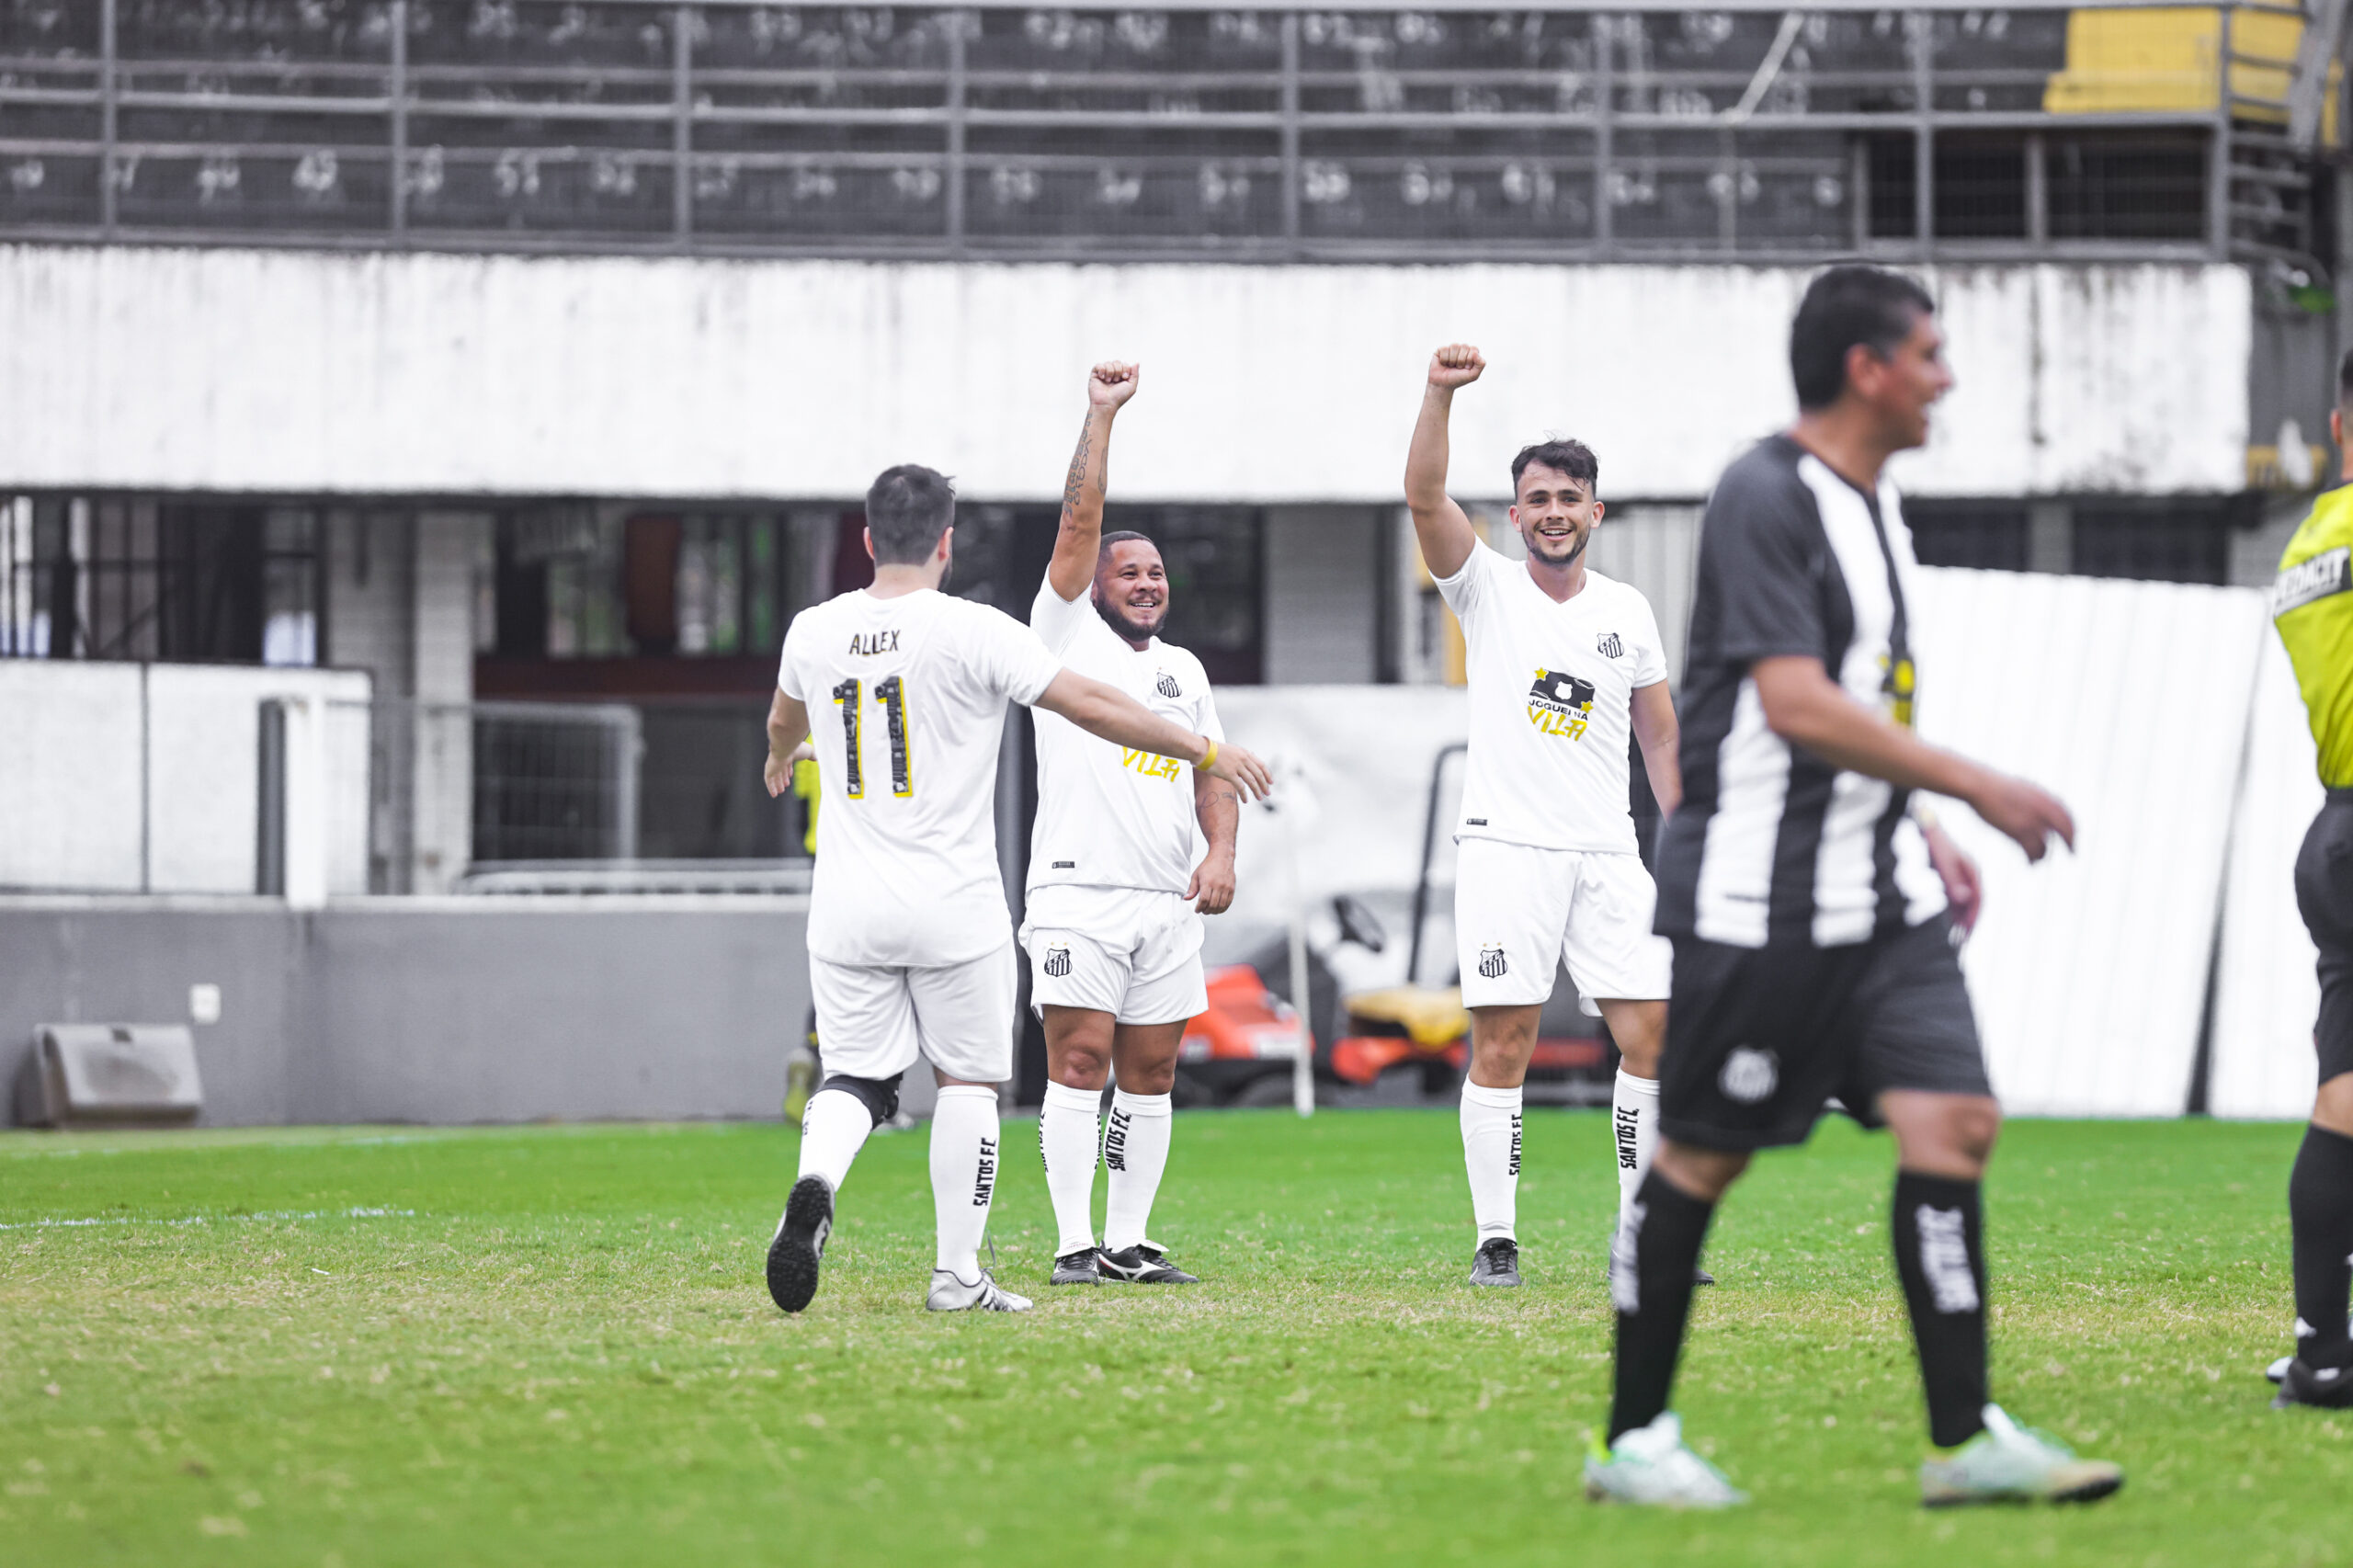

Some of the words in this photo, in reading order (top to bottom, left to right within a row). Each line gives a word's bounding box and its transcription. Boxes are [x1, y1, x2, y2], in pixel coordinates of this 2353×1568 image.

[849, 630, 900, 656] ALLEX
[1527, 705, 1588, 742] VILA
[1528, 699, 1572, 716] JOGUEI
[1574, 710, 1588, 722] NA
[833, 676, 914, 800] 11
[1122, 745, 1181, 783] VILA
[1104, 1126, 1127, 1172] SANTOS
[1508, 1131, 1521, 1176] SANTOS
[1617, 1122, 1637, 1170] SANTOS
[972, 1158, 994, 1207] SANTOS
